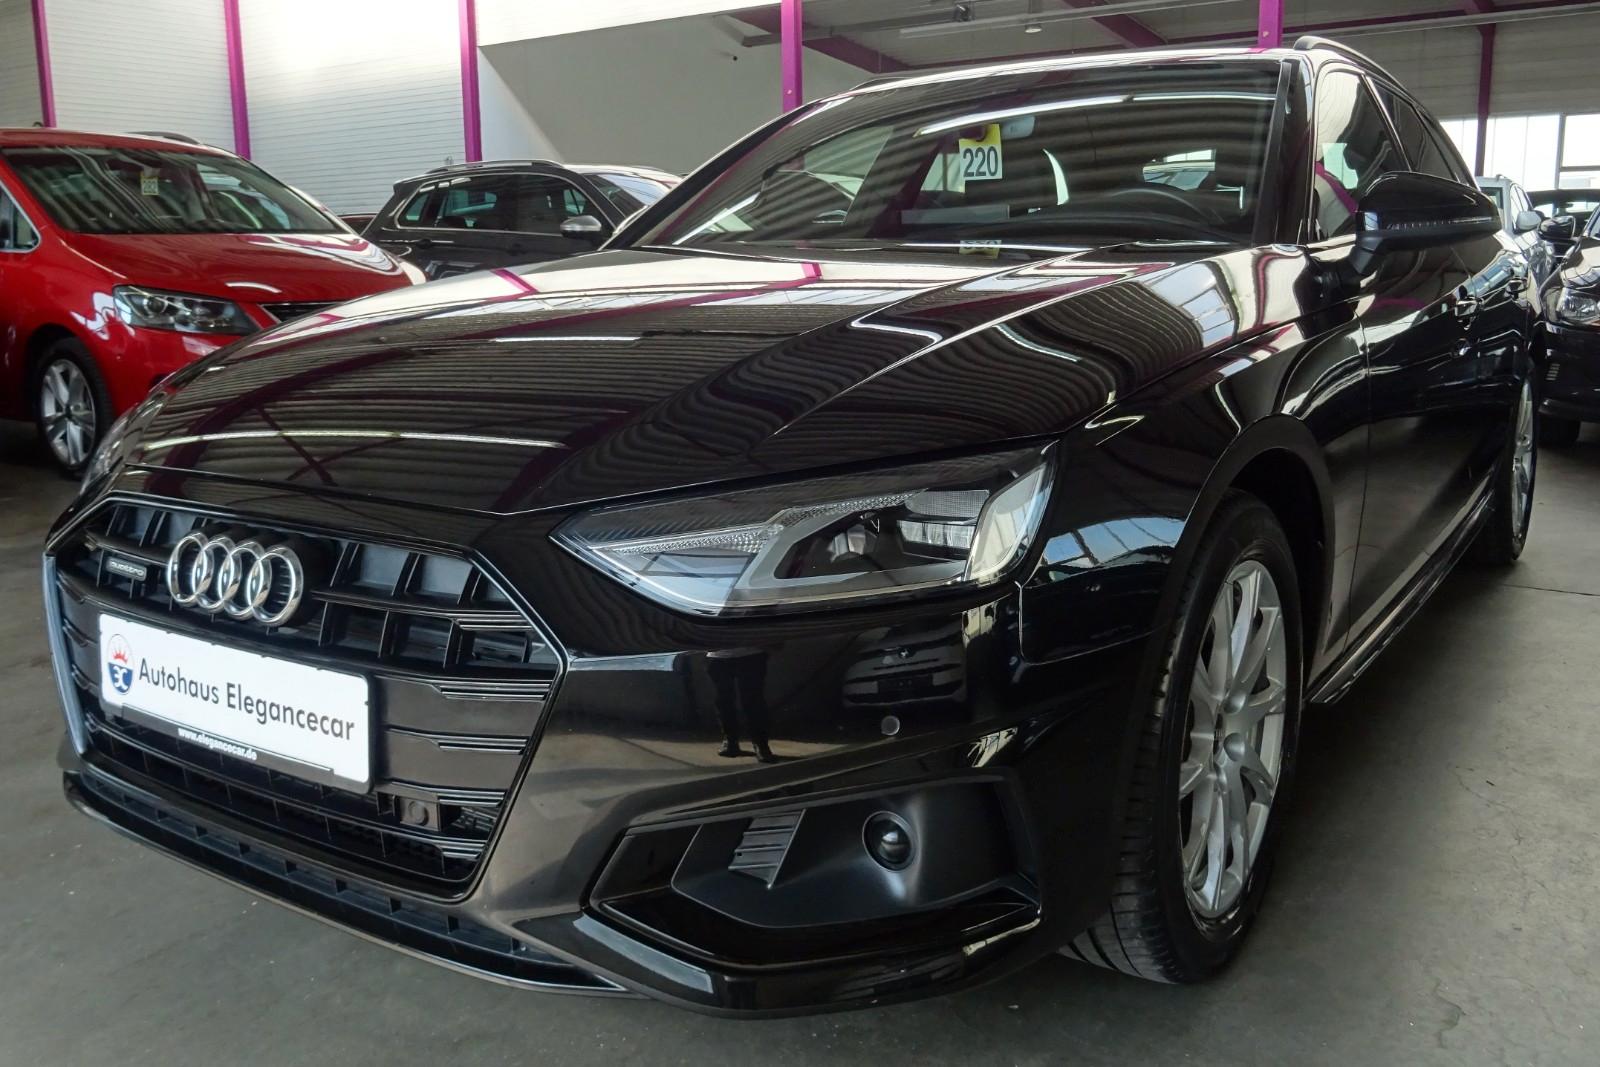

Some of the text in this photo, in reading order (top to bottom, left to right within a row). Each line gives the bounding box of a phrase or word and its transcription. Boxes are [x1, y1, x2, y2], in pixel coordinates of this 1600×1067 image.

[962, 146, 998, 177] 220
[139, 657, 355, 740] Autohaus Elegancecar
[177, 727, 258, 761] www.elegancecar.de
